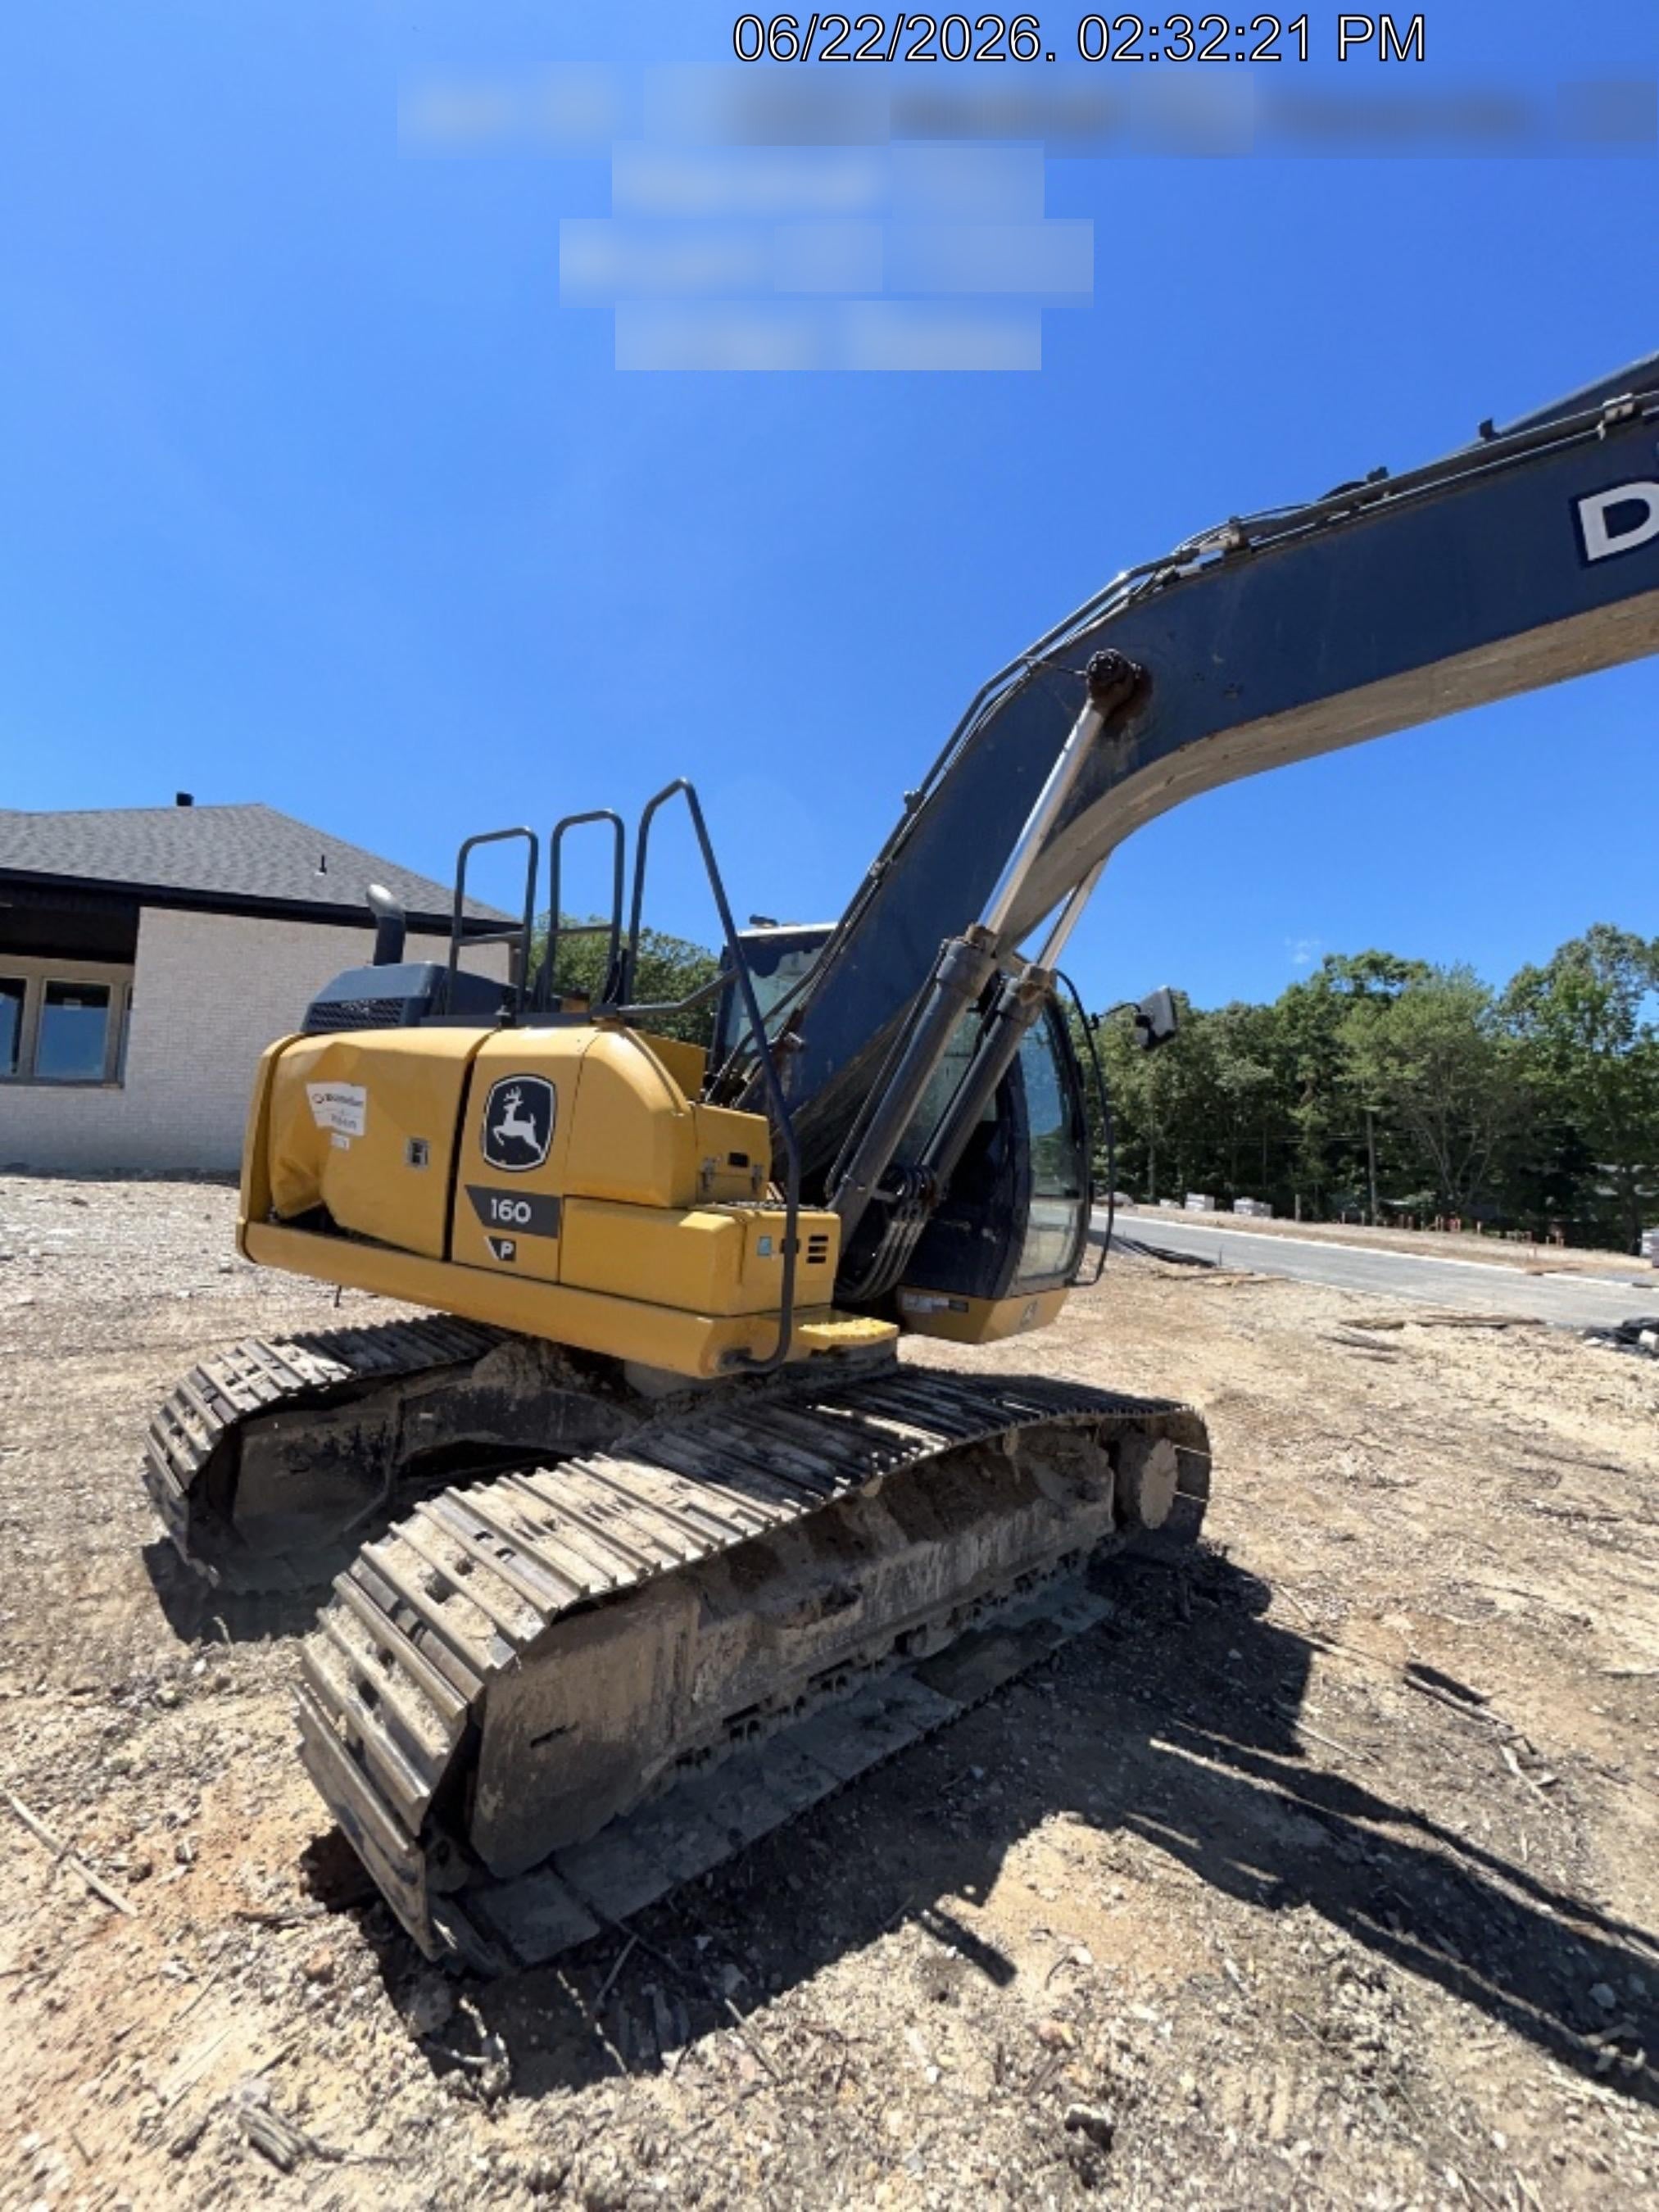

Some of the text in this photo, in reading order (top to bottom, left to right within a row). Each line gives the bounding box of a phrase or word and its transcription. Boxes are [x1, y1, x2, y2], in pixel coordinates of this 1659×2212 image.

[1578, 481, 1659, 561] D
[491, 1198, 531, 1223] 160
[501, 1240, 514, 1258] P
